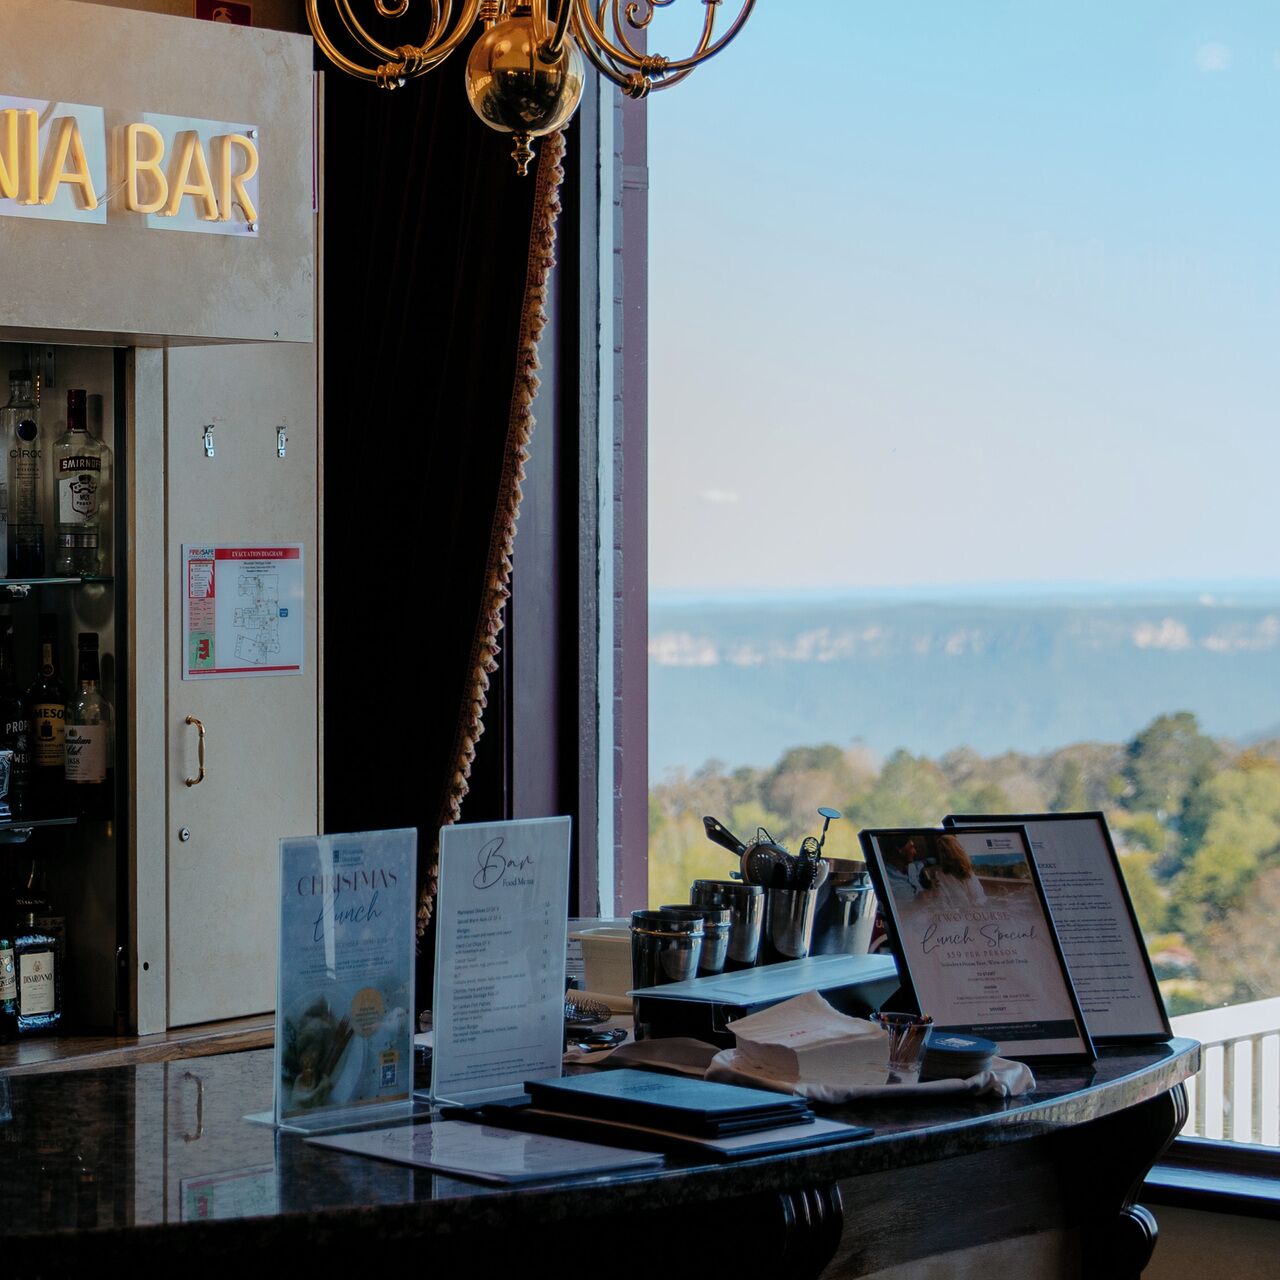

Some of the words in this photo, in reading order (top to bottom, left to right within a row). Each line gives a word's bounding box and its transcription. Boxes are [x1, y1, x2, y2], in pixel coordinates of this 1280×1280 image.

[124, 121, 261, 226] BAR
[473, 836, 534, 890] Bar
[502, 878, 517, 888] Food
[517, 878, 534, 886] Menu
[936, 911, 962, 922] TWO
[963, 911, 1010, 922] COURSE
[920, 923, 975, 955] Lunch
[980, 923, 1038, 948] Special
[965, 950, 981, 958] PER
[983, 949, 1018, 957] PERSON
[23, 972, 53, 985] DISARONNO
